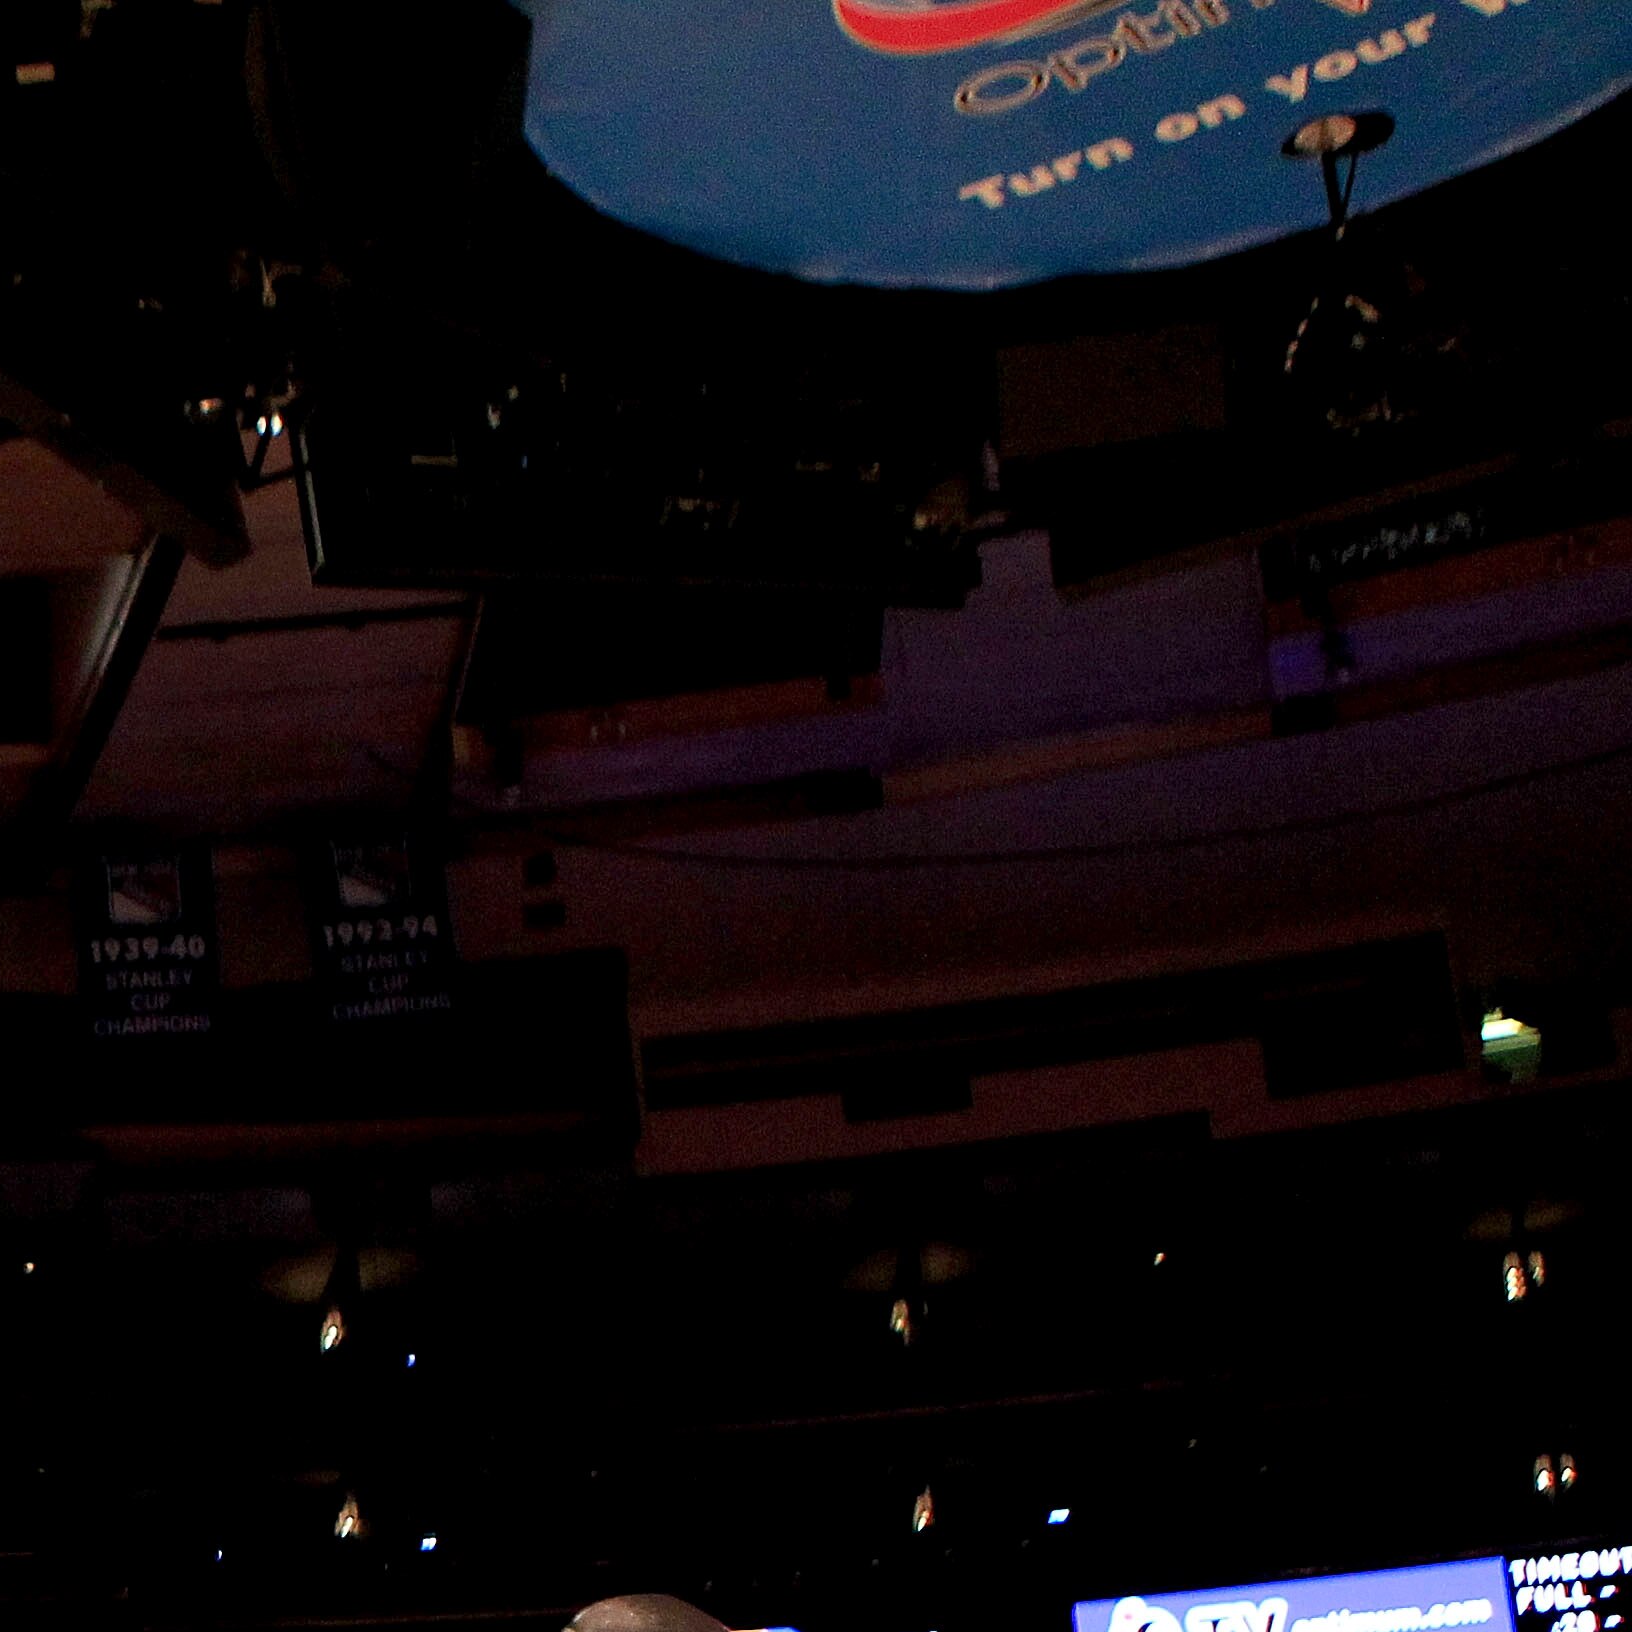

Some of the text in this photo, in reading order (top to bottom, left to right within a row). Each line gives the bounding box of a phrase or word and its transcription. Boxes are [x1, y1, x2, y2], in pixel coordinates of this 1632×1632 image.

[1264, 11, 1436, 104] your
[958, 94, 1247, 208] Turn on
[90, 932, 207, 964] 1939-40
[104, 967, 194, 992] STANLEY
[129, 991, 173, 1013] CUP
[93, 1012, 213, 1038] CHAMPIONS
[1516, 1581, 1593, 1616] FULL
